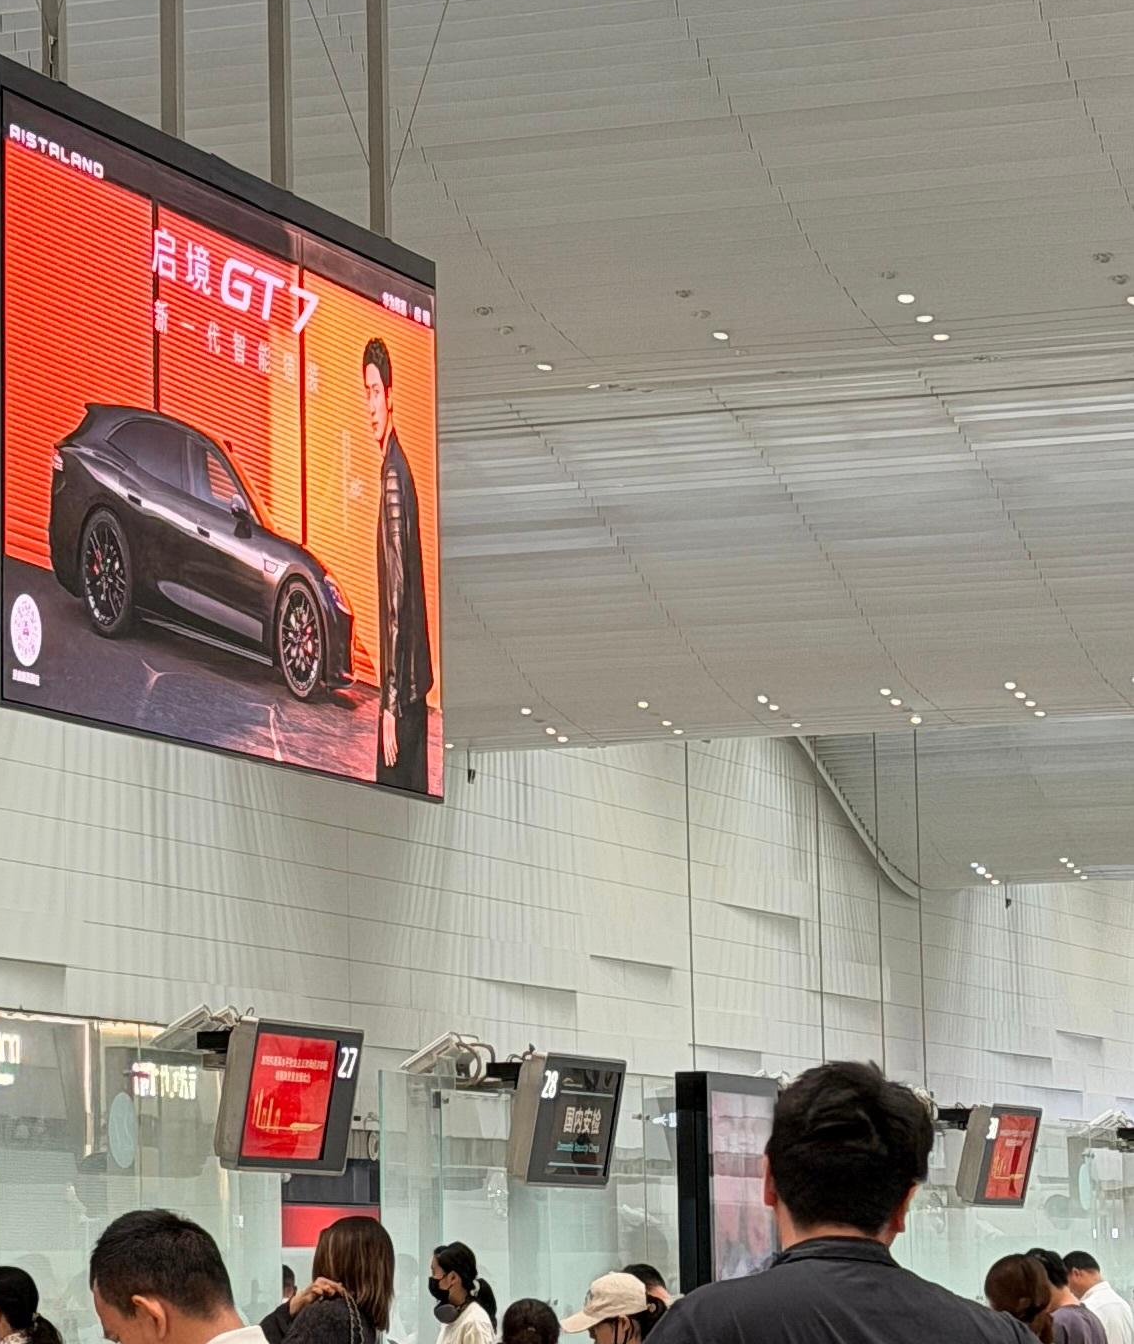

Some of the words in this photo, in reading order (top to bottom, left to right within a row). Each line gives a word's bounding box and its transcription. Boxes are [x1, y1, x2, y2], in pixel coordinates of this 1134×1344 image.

[9, 123, 104, 179] AISTALAND
[337, 1047, 358, 1078] 27
[541, 1070, 559, 1098] 28
[563, 1105, 602, 1134] 国内安检
